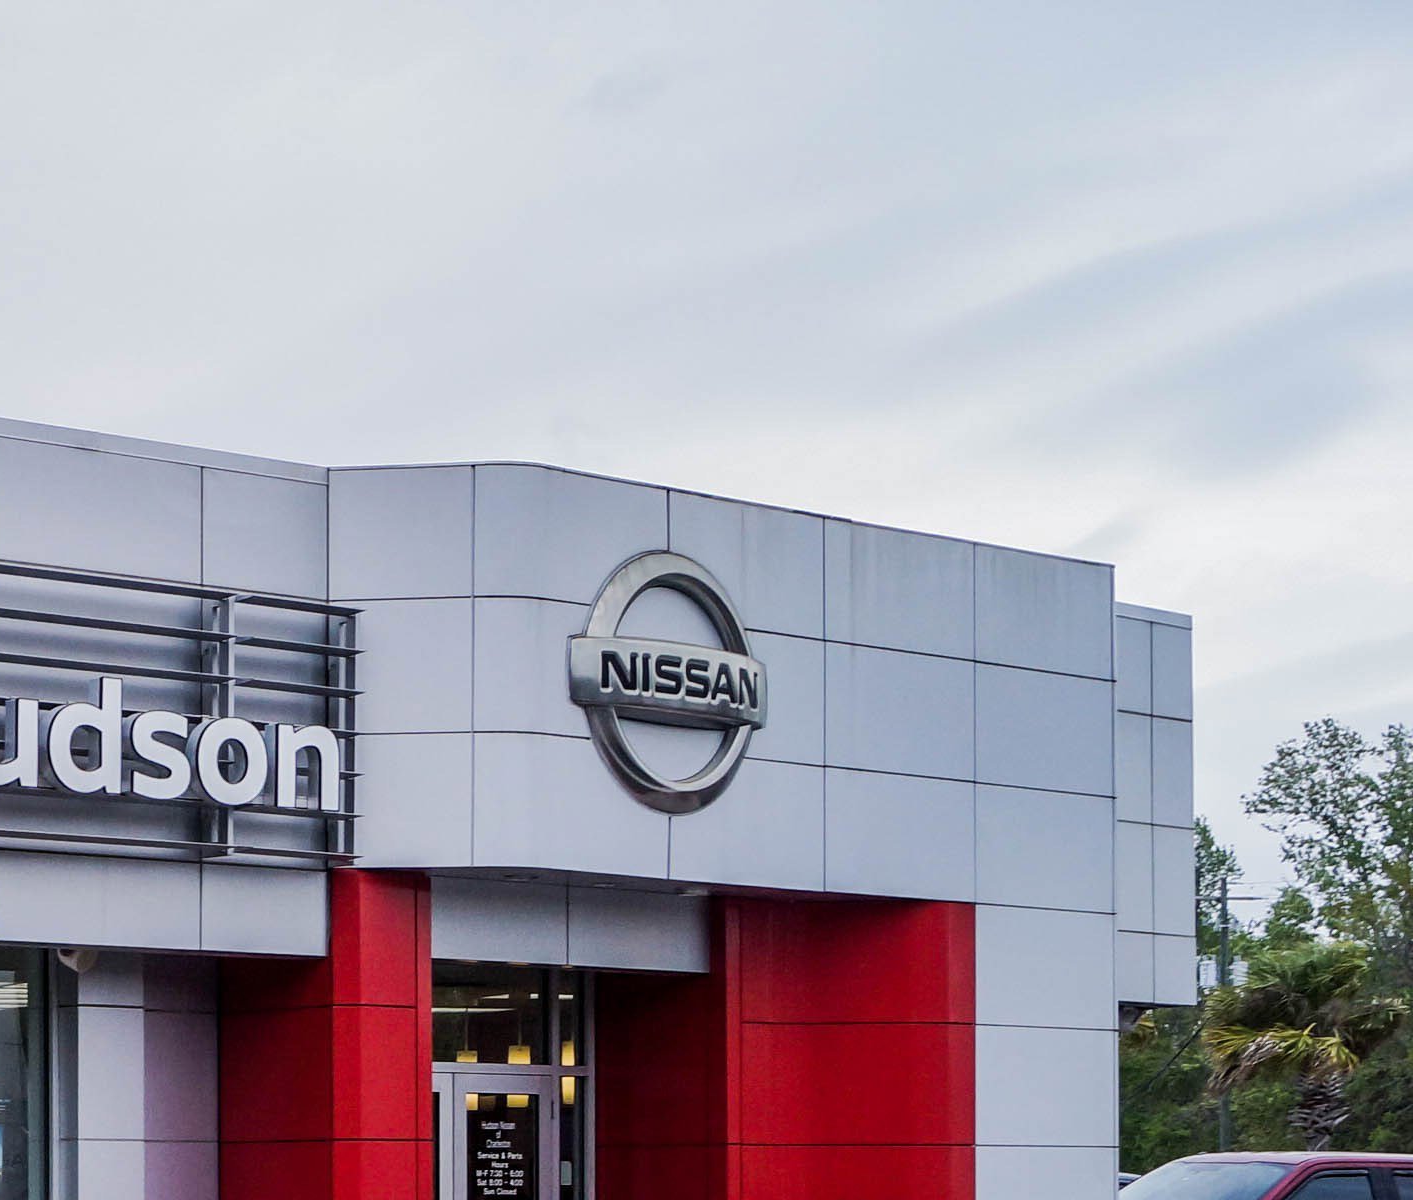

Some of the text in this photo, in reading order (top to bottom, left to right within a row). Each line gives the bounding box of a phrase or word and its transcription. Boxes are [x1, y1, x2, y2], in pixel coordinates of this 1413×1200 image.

[600, 650, 759, 710] NISSAN
[477, 1151, 499, 1159] Service
[507, 1151, 523, 1159] Parts
